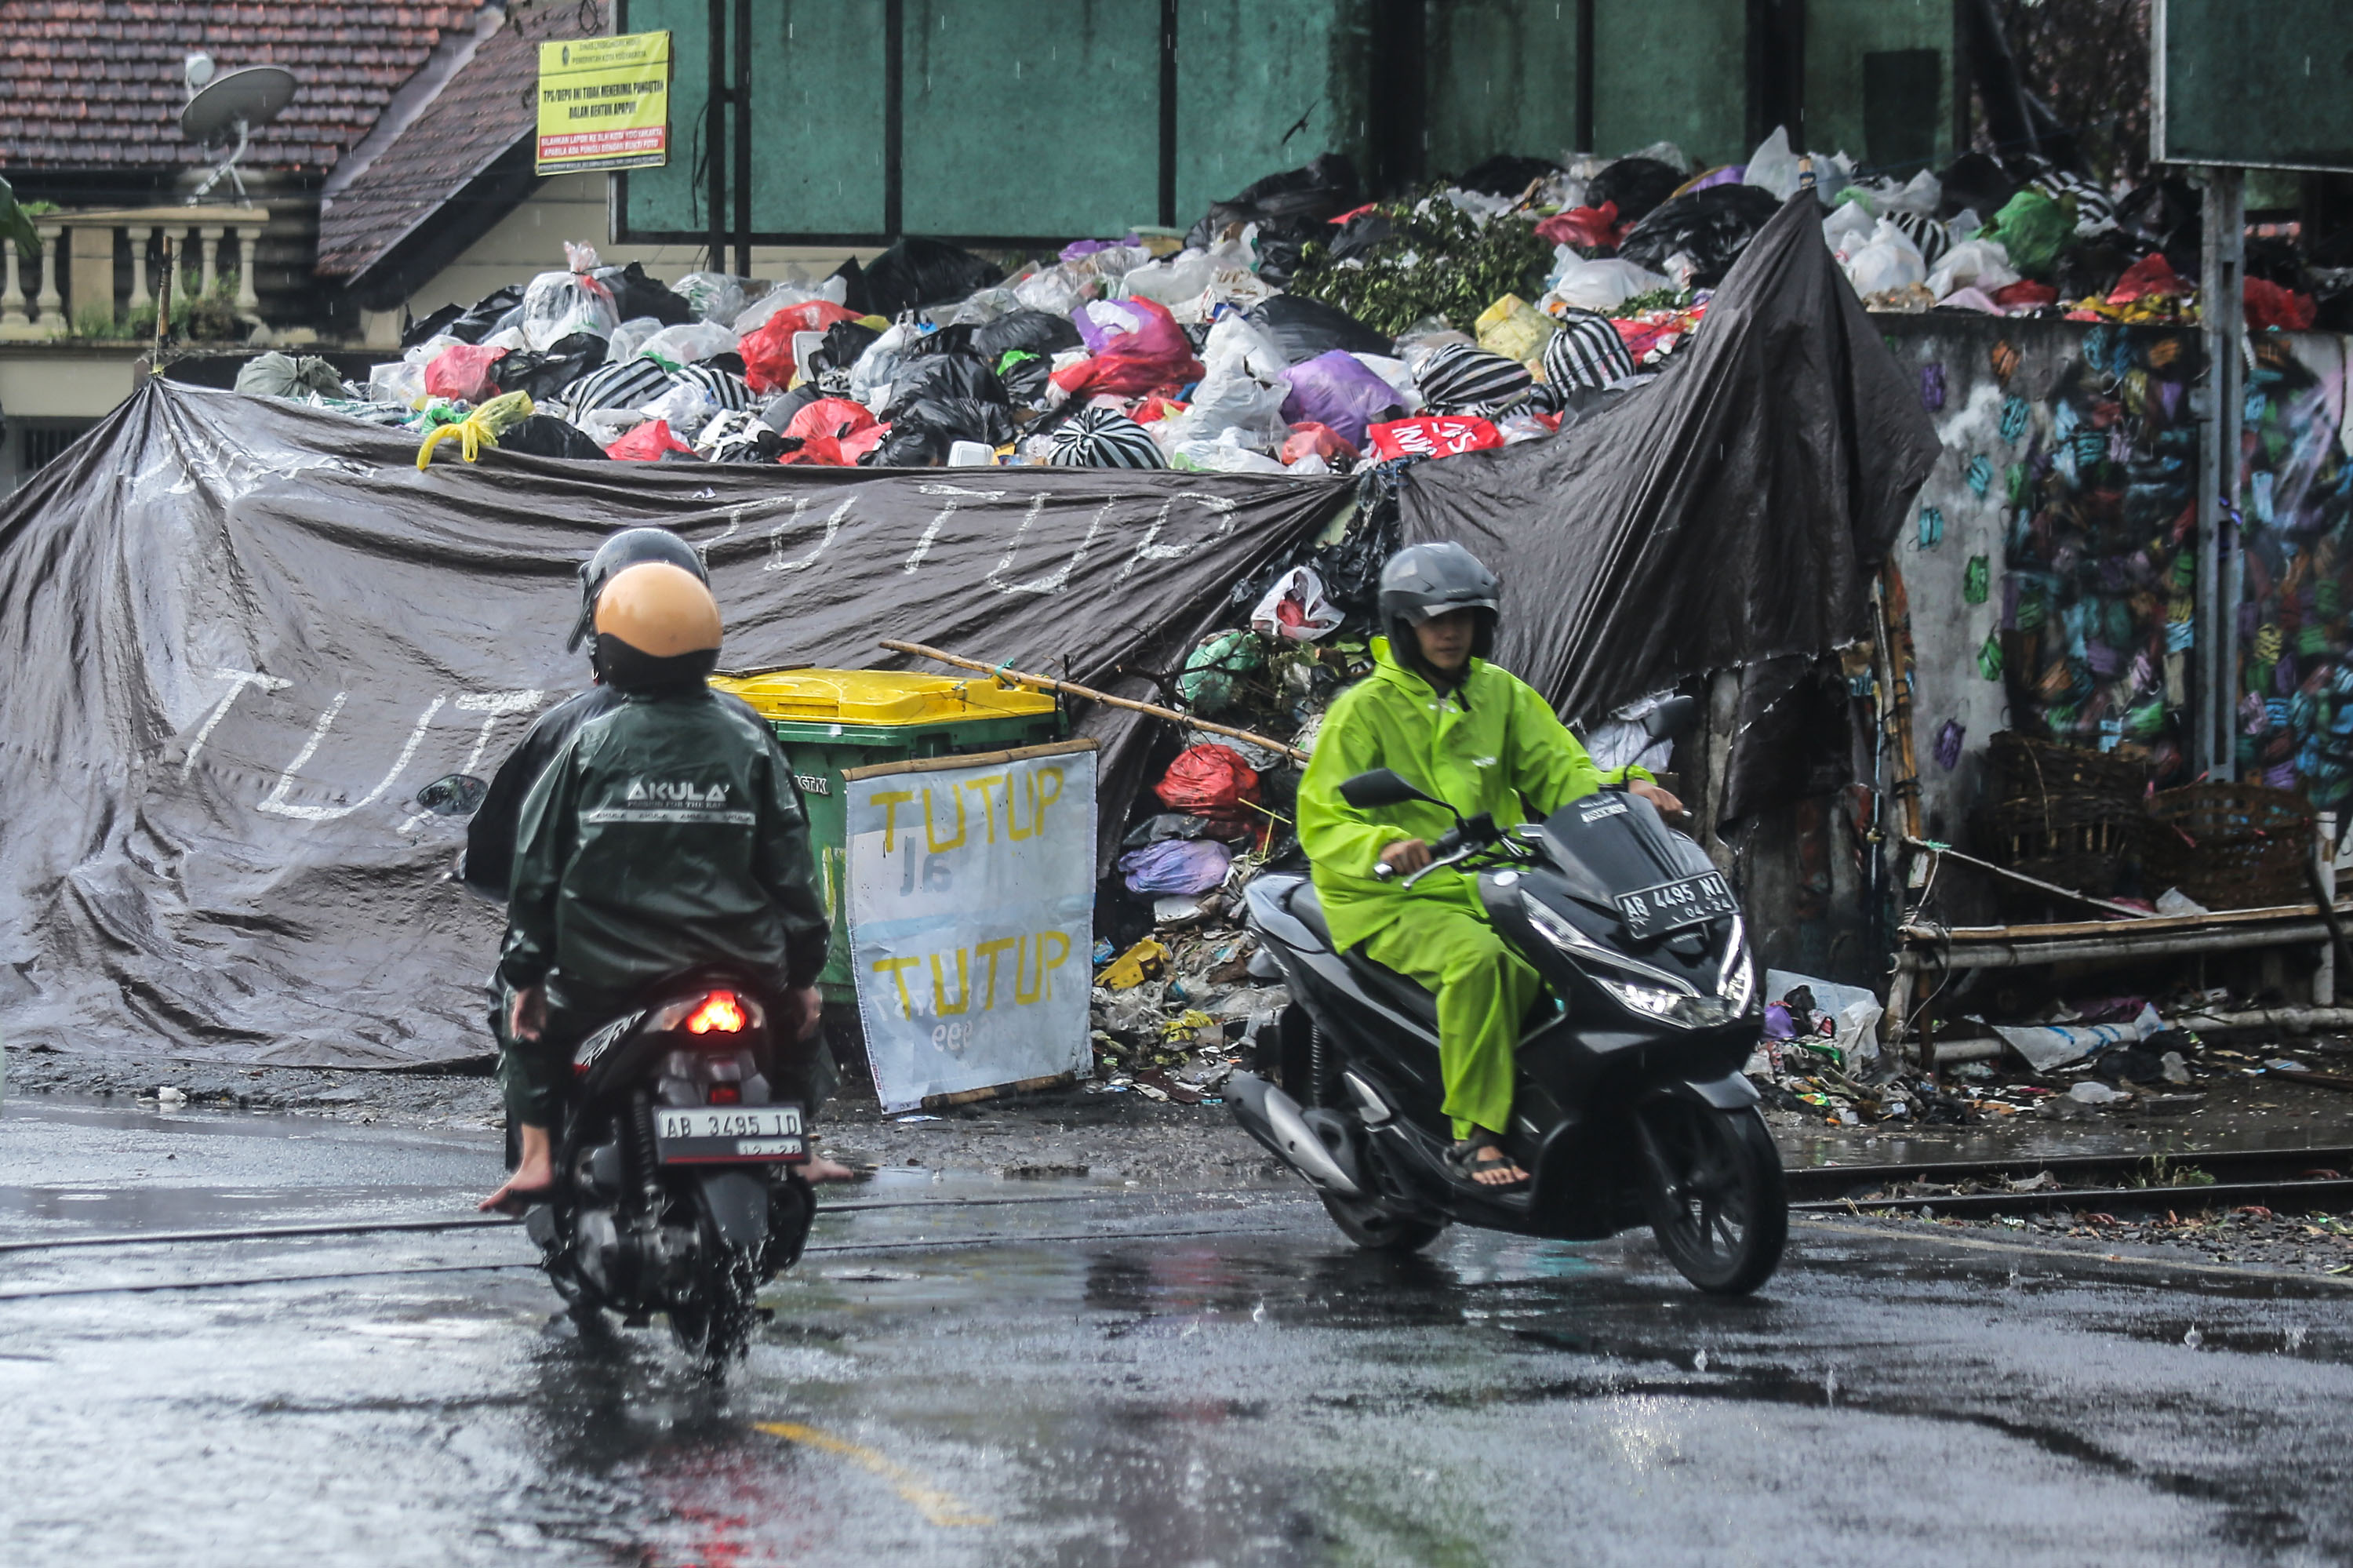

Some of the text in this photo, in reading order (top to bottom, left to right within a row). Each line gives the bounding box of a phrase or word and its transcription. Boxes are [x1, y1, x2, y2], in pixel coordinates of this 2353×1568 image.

[627, 780, 726, 802] AKULA
[666, 800, 683, 809] FOR
[685, 800, 704, 809] THE
[871, 766, 1064, 854] TUTUP
[1623, 877, 1724, 918] AB 4495 NI
[873, 930, 1071, 1022] TUTUP
[666, 1115, 692, 1137] AB
[707, 1114, 760, 1137] 3495
